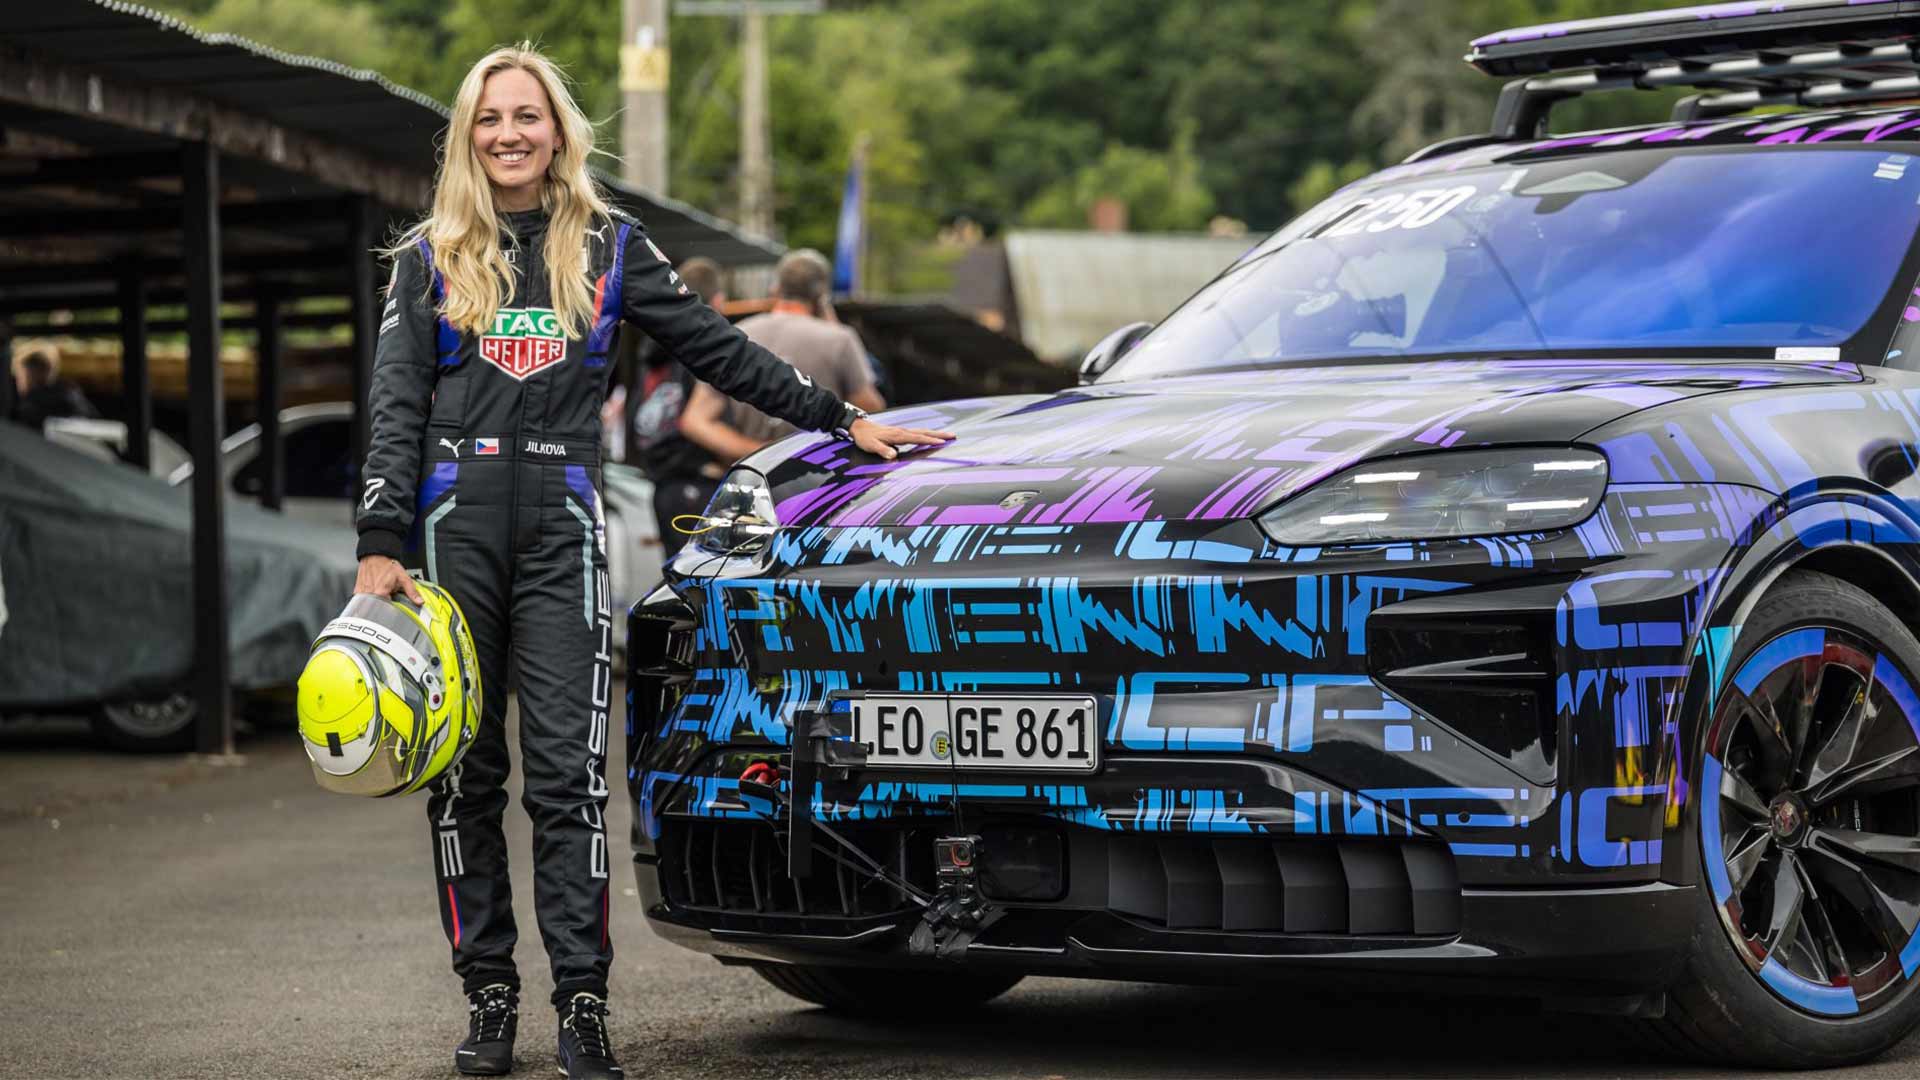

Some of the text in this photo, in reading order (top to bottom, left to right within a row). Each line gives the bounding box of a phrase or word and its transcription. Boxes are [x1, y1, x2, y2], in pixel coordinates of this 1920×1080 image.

[495, 312, 560, 335] TAG
[485, 339, 562, 374] HEUER
[524, 440, 567, 456] JILKOVA
[581, 568, 612, 878] PORSCHE
[852, 705, 925, 756] LEO
[955, 706, 1004, 758] GE
[1015, 707, 1090, 759] 861
